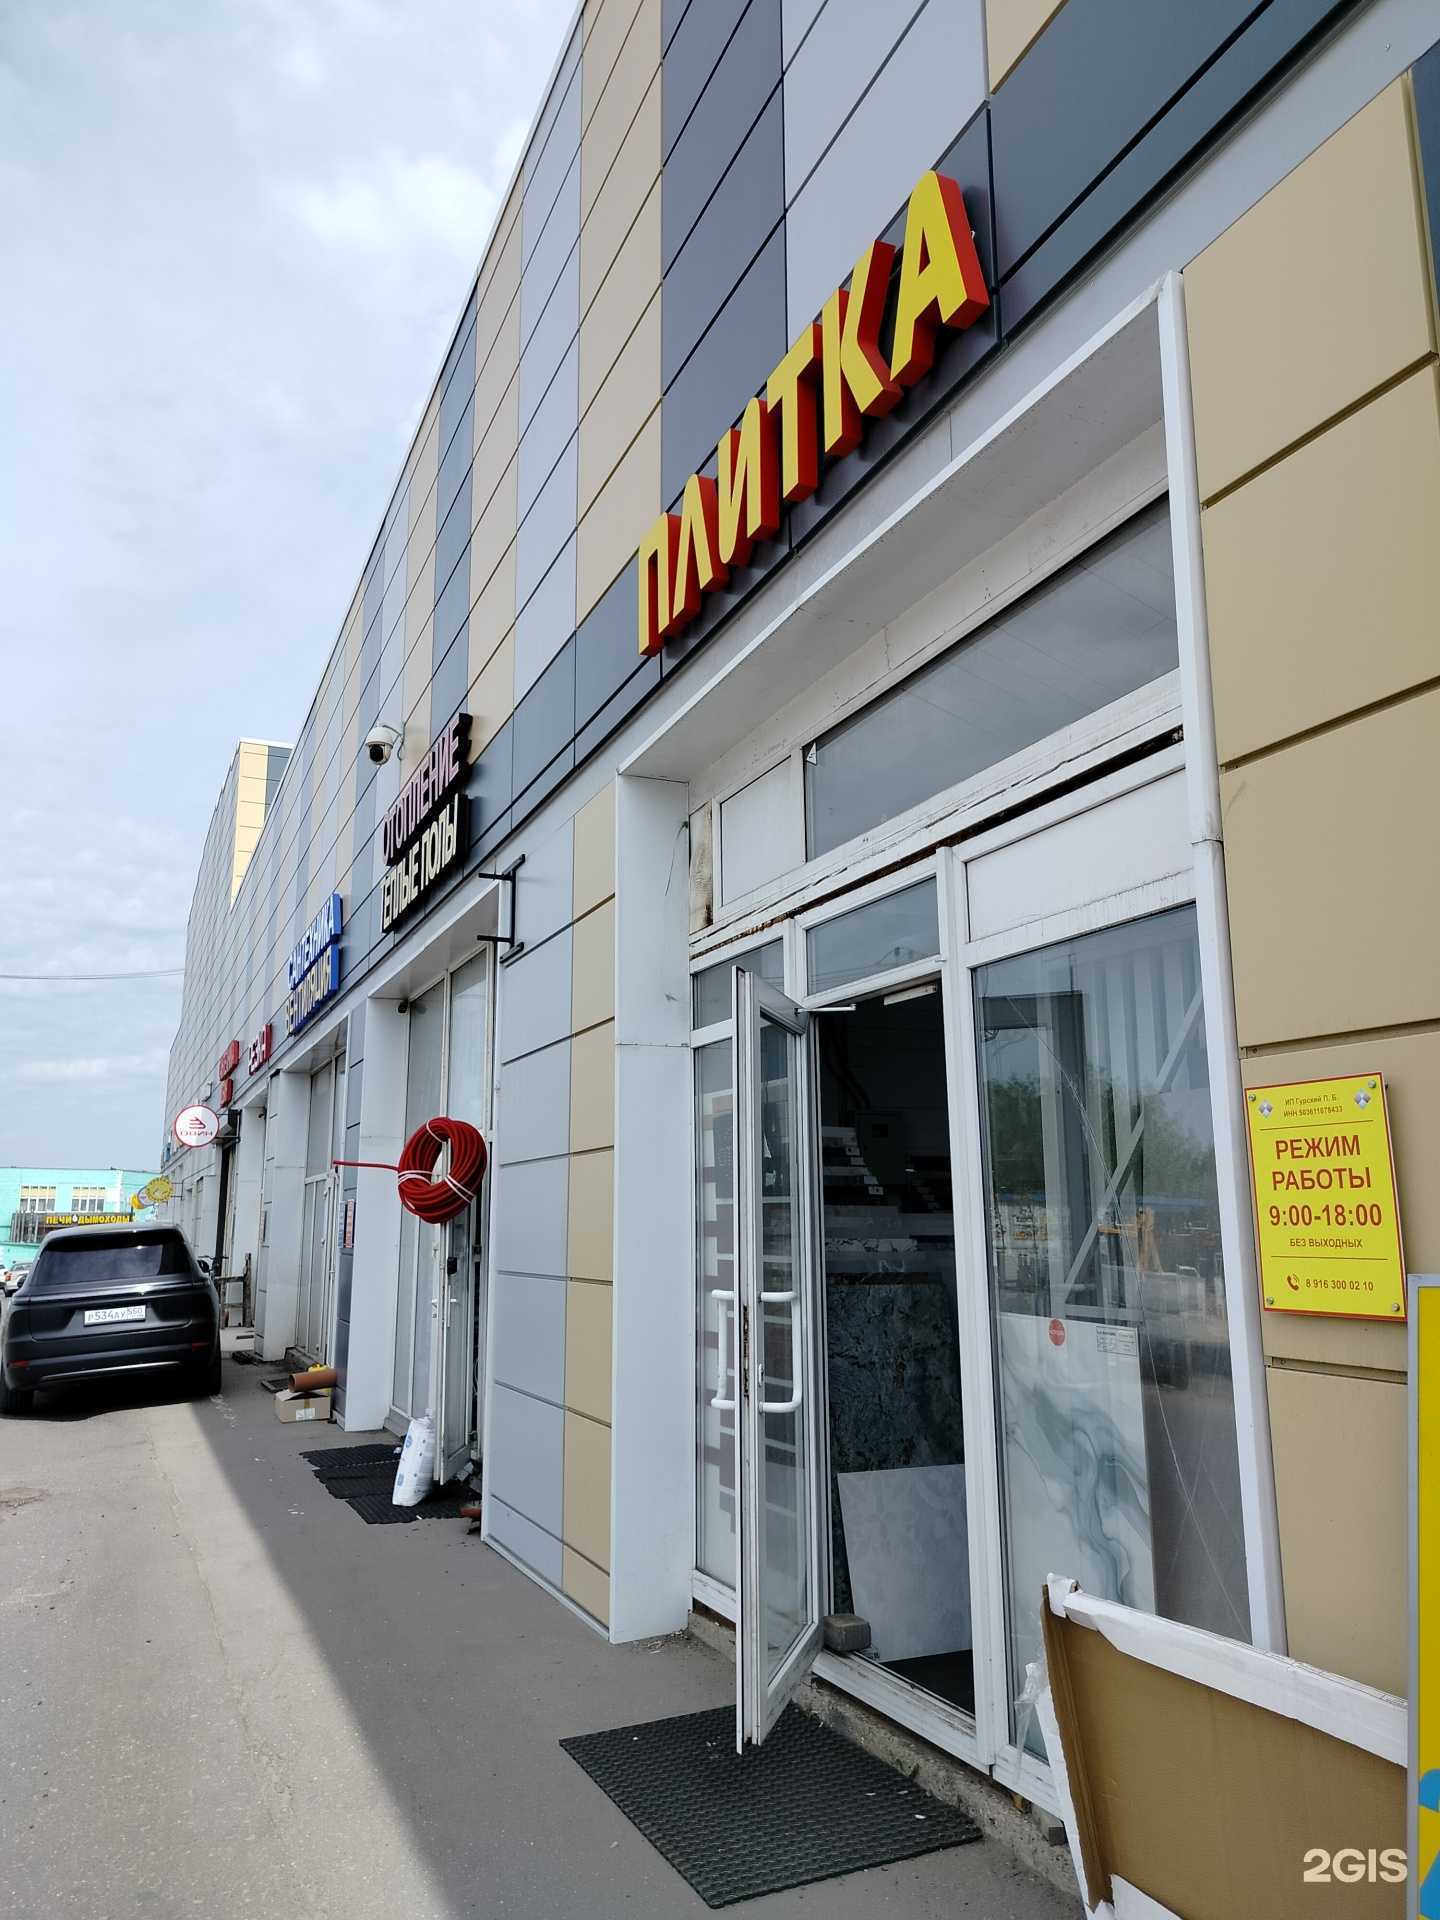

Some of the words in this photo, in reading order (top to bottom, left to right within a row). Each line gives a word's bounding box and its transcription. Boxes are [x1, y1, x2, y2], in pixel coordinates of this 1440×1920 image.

[638, 169, 990, 657] ПЛИТКА
[382, 717, 461, 866] ОТОПЛЕНИЕ
[420, 793, 460, 891] ПОЛЫ
[287, 893, 336, 991] САНТЕХНИКА
[1285, 1097, 1295, 1106] ИП
[1275, 1134, 1361, 1160] РЕЖИМ
[1271, 1166, 1371, 1191] РАБОТЫ
[46, 1214, 72, 1225] ПЕЧИ
[77, 1214, 130, 1225] ДЫМОХОДЫ
[1269, 1203, 1382, 1227] 9:00-18:00
[1289, 1238, 1306, 1248] БЕЗ
[1309, 1238, 1363, 1249] ВЫХОДНЫХ
[1305, 1278, 1311, 1289] 8
[1312, 1278, 1330, 1290] 916
[1331, 1279, 1347, 1290] 300
[1348, 1280, 1360, 1291] 02
[1363, 1281, 1374, 1291] 10
